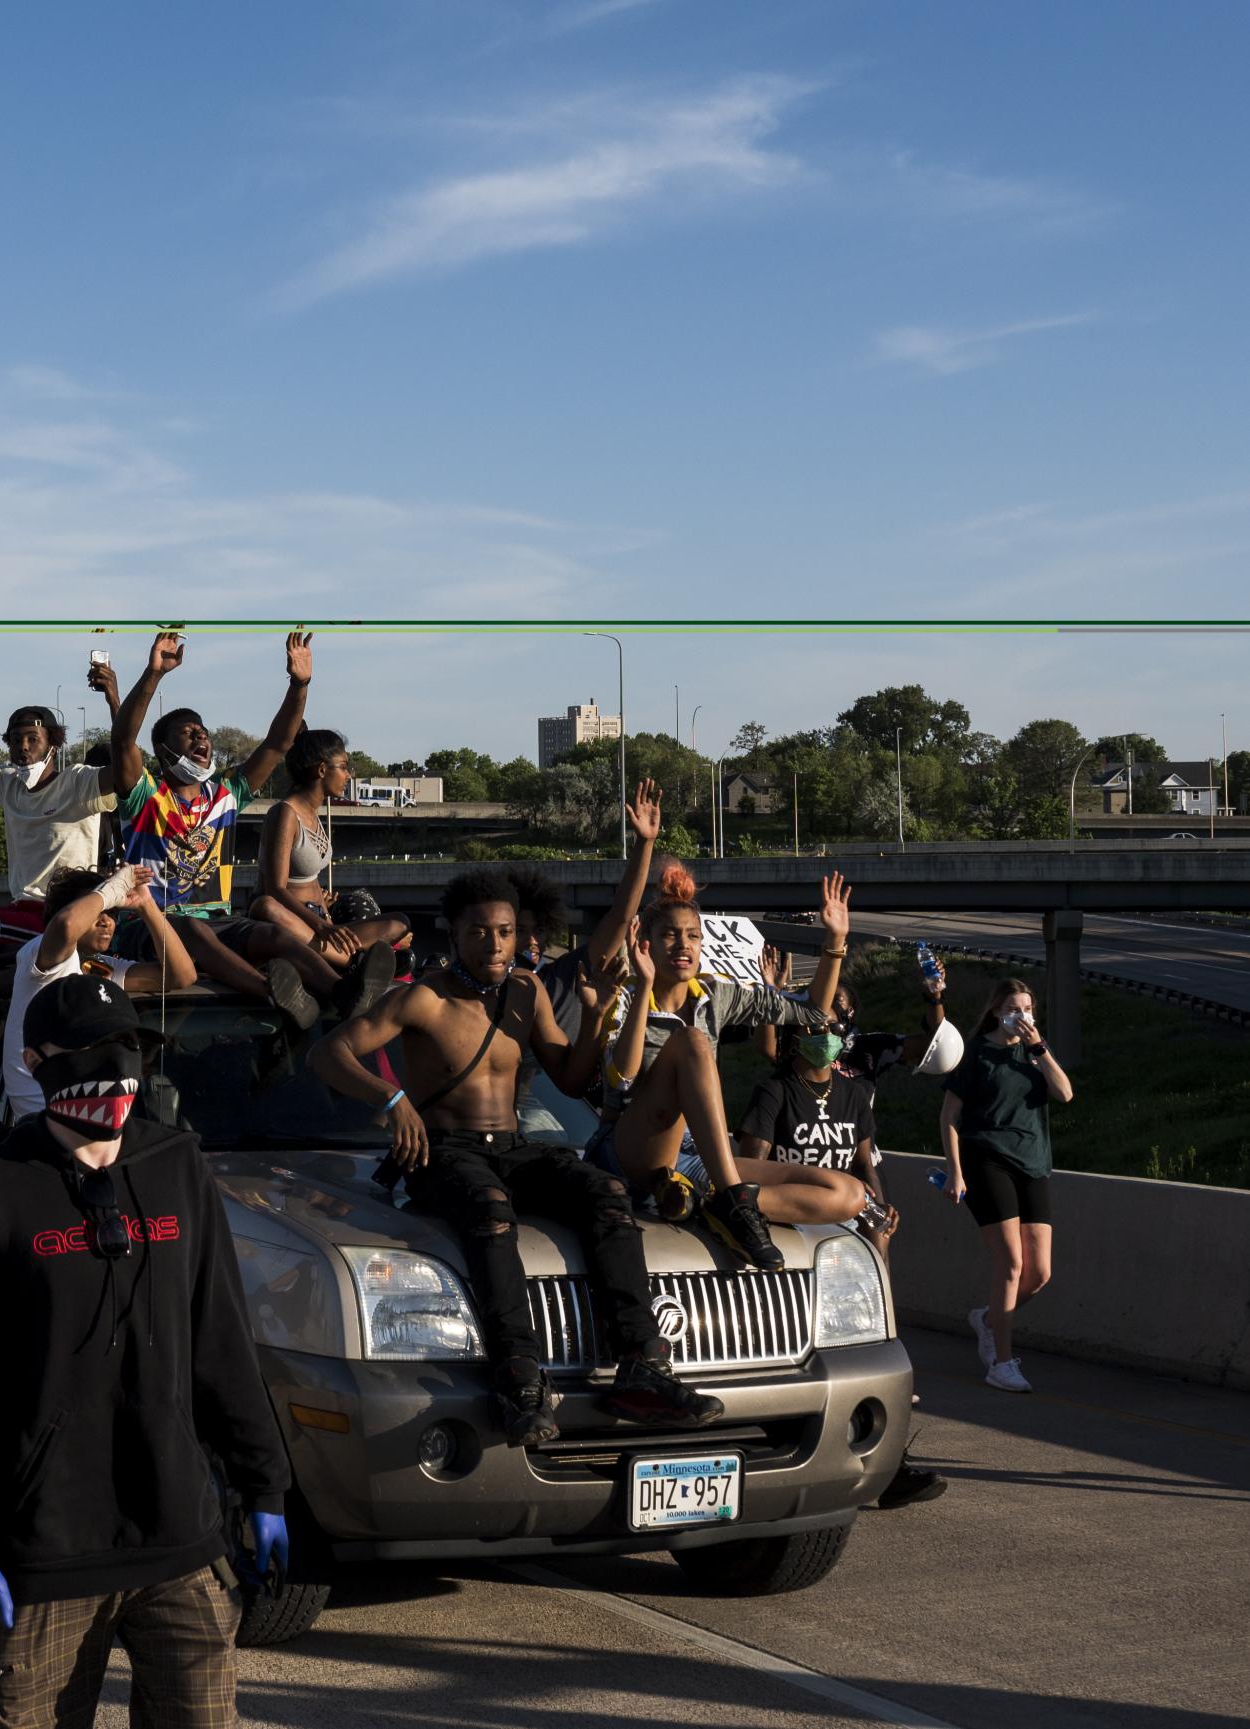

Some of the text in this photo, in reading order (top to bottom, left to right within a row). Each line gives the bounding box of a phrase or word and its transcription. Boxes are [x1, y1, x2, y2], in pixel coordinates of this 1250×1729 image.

[704, 919, 753, 945] CK
[816, 1099, 830, 1120] I
[793, 1122, 855, 1145] CAN'T
[776, 1144, 857, 1170] BREATH
[662, 1463, 711, 1475] Minnesota
[639, 1475, 732, 1511] DHZ 957
